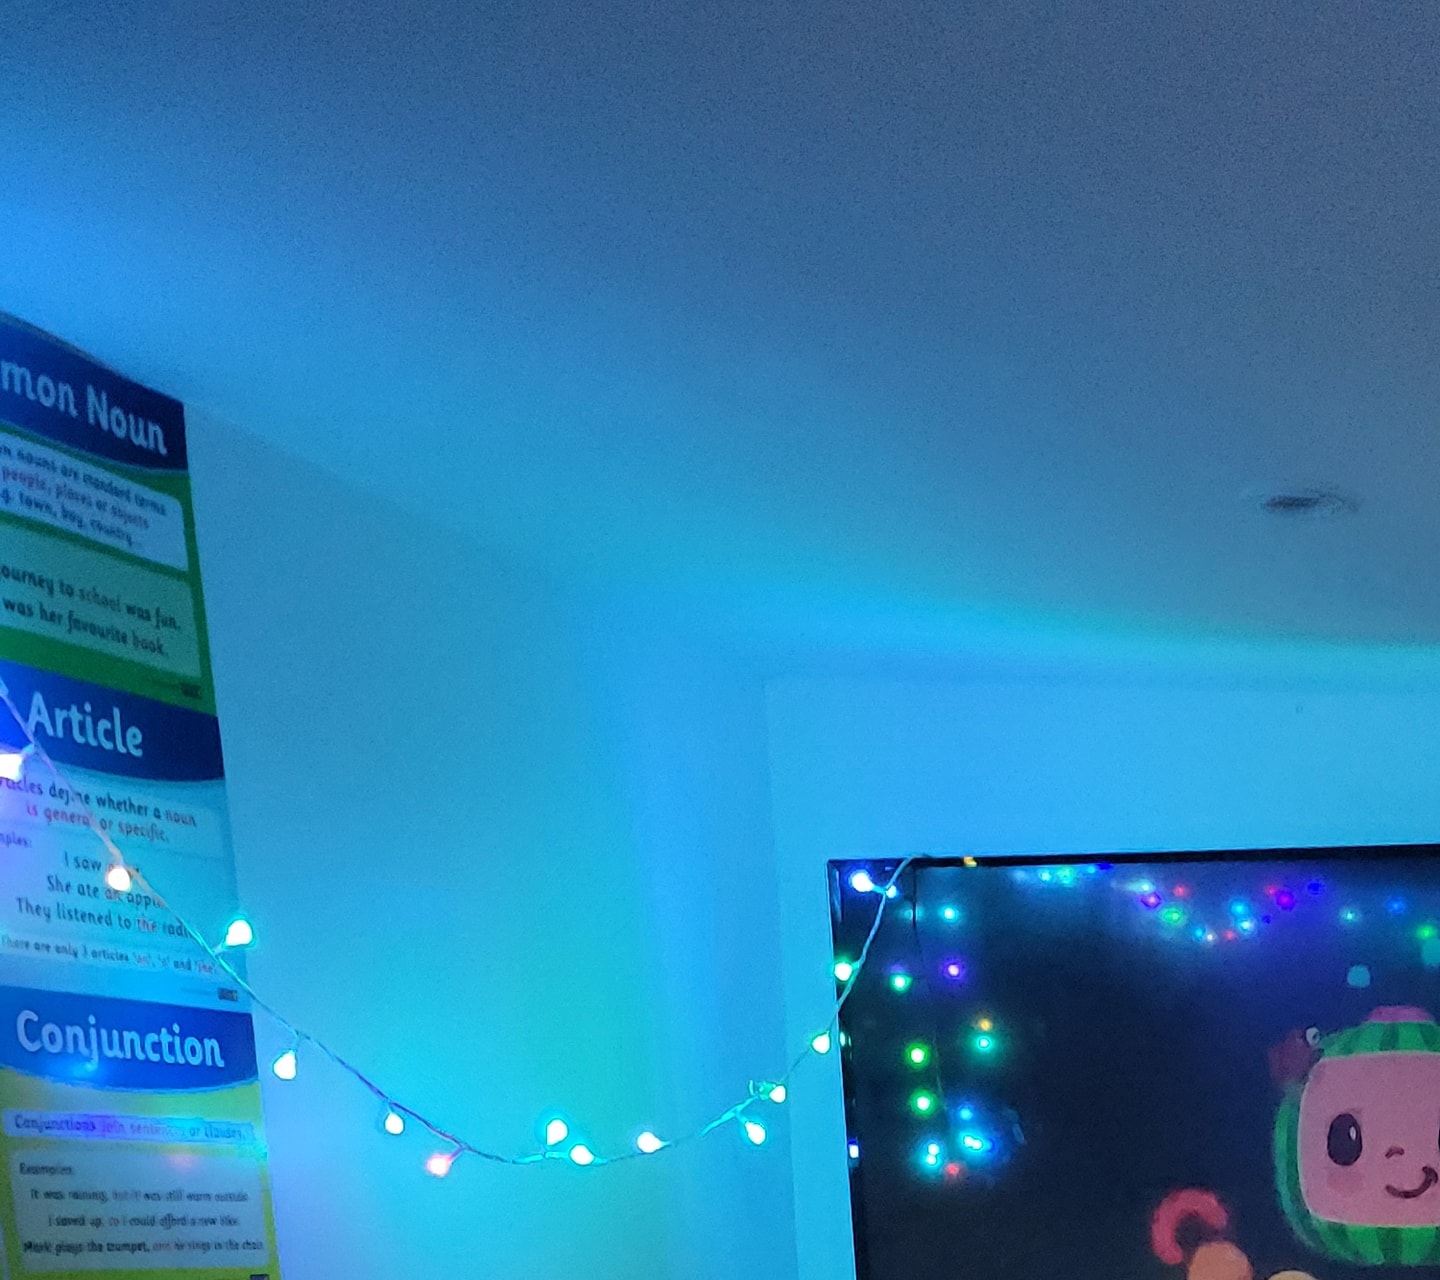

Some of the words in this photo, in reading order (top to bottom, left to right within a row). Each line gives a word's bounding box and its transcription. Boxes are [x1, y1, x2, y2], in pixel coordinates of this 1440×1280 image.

[87, 383, 168, 457] Noun
[27, 690, 144, 758] Article
[95, 792, 149, 818] whether
[74, 855, 102, 872] saw
[46, 874, 72, 895] She
[16, 896, 52, 923] They
[56, 901, 113, 928] listened
[16, 1009, 226, 1073] Conjunction
